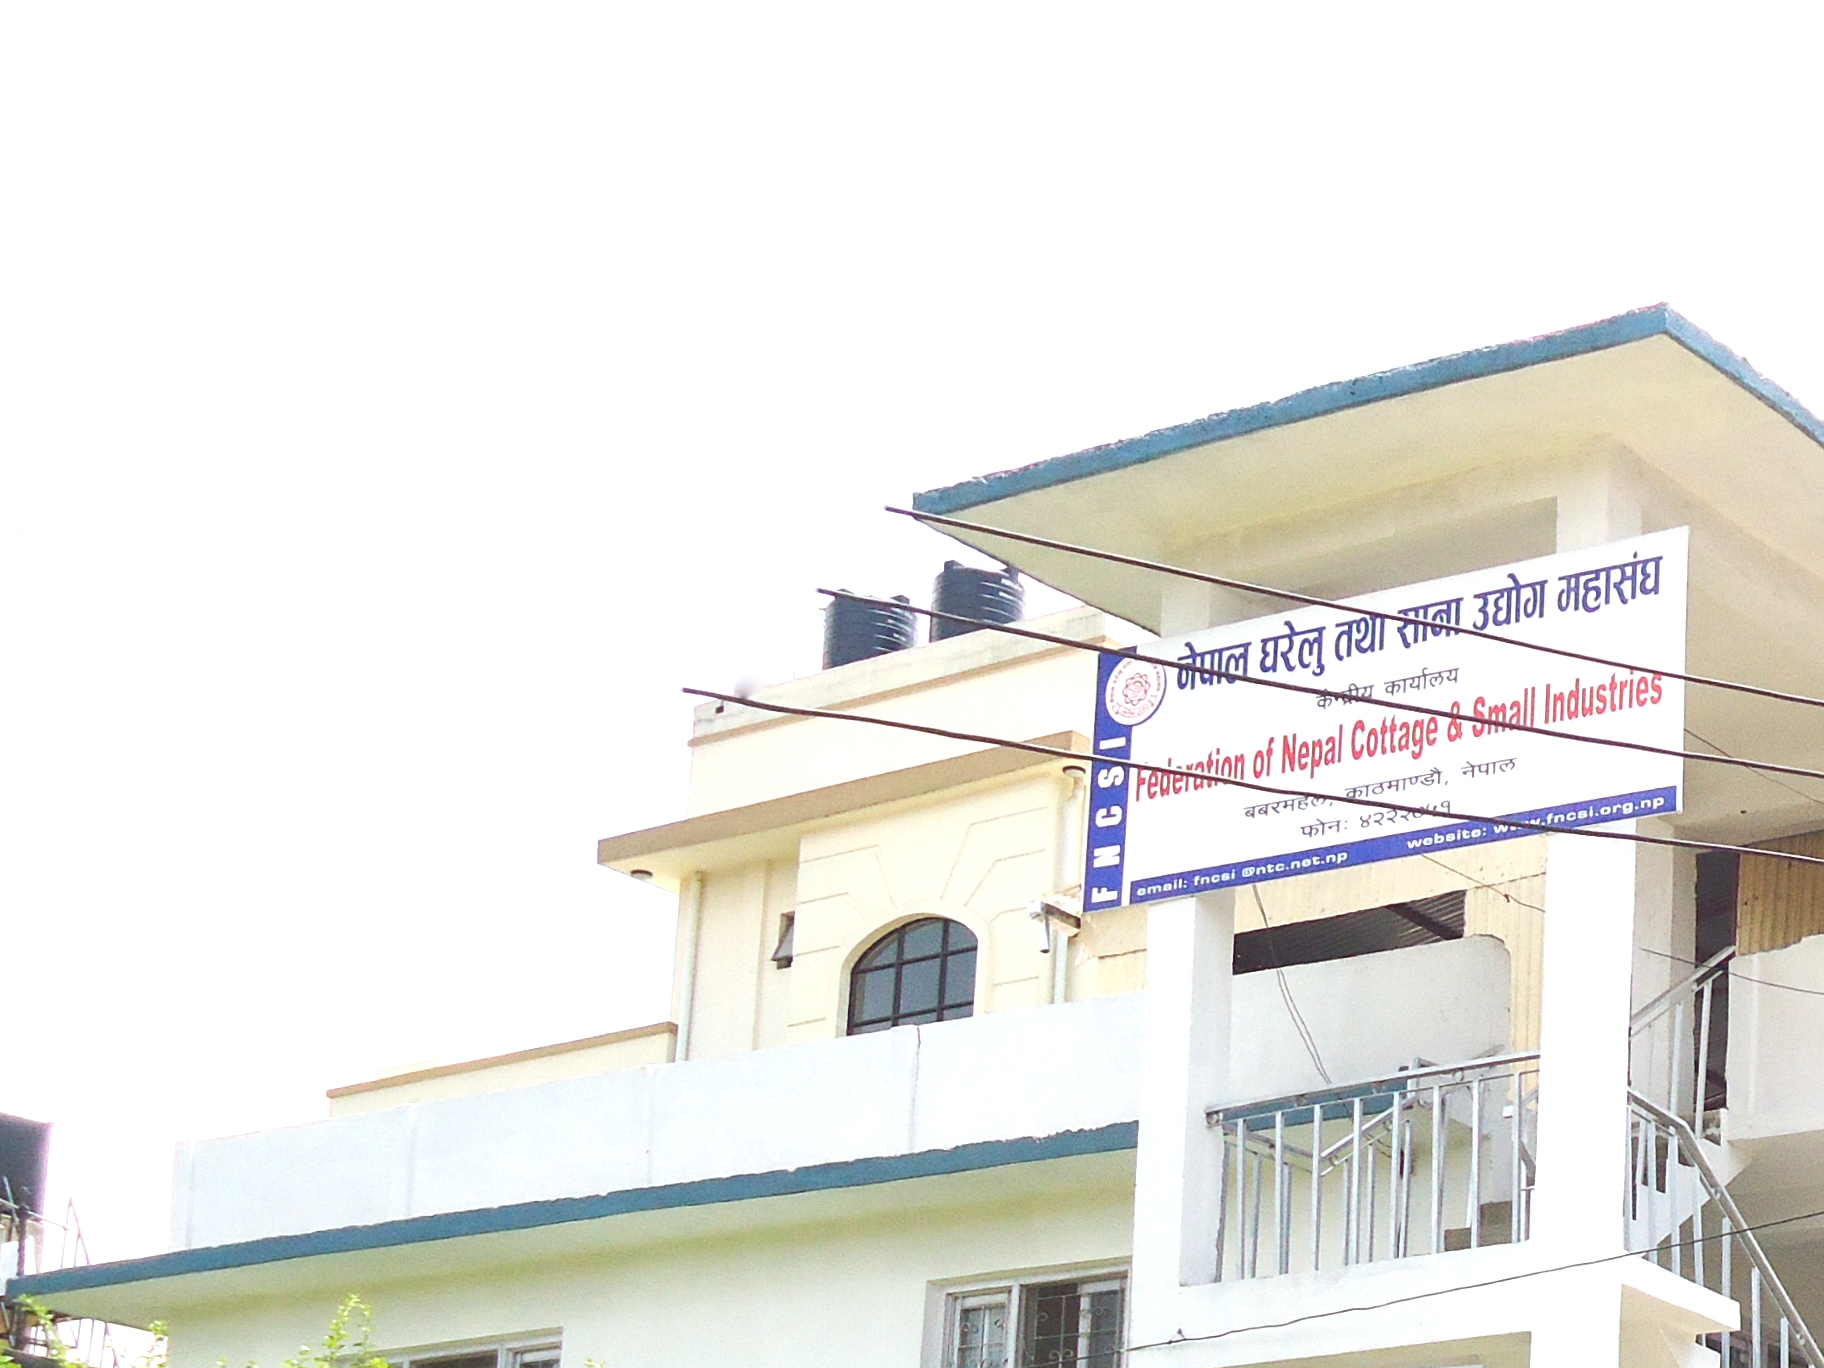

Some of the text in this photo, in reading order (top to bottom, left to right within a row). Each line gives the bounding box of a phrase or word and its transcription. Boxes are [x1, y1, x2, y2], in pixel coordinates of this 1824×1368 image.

[1177, 641, 1253, 690] नेपाल
[1259, 620, 1326, 677] घरेलु
[1335, 613, 1386, 662] तथा
[1397, 596, 1464, 649] साना
[1472, 573, 1548, 631] उद्योग
[1557, 551, 1663, 613] महासंघ
[1384, 667, 1460, 696] कार्यालय
[1135, 668, 1663, 802] Federation of Nepal Cottage & Small Industries
[1460, 757, 1518, 779] नेपाल
[1136, 877, 1188, 897] email:
[1193, 868, 1236, 887] fncsi
[1407, 826, 1487, 849] website:
